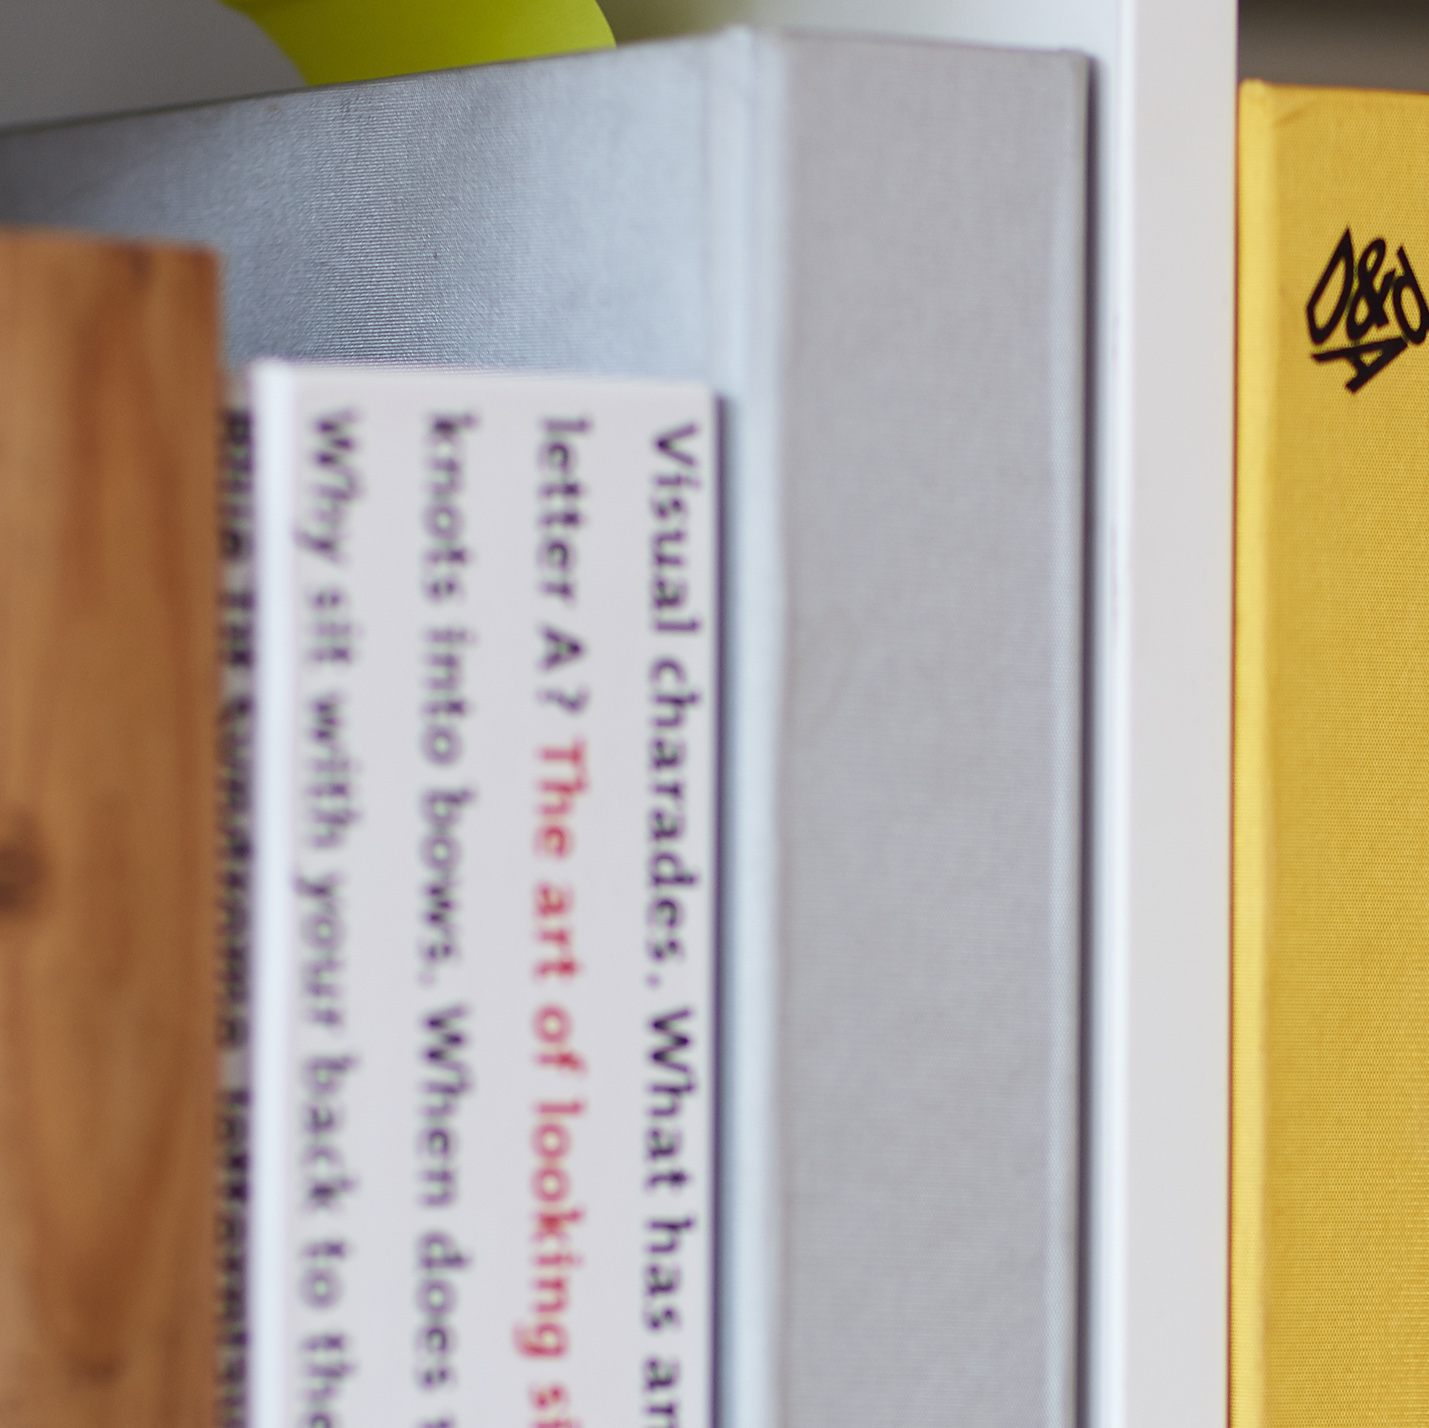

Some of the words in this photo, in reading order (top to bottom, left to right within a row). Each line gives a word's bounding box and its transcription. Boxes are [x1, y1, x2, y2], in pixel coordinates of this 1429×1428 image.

[295, 408, 361, 563] Why
[421, 411, 480, 604] knots
[538, 417, 592, 604] letter
[651, 423, 701, 633] Visual
[308, 588, 361, 665] sit
[421, 626, 477, 768] into
[308, 692, 361, 849] with
[536, 737, 589, 858] The
[649, 657, 701, 987] charades.
[294, 872, 343, 1031] your
[419, 786, 477, 987] bows.
[533, 882, 582, 978] art
[418, 1003, 474, 1209] When
[532, 1003, 587, 1076] of
[646, 1007, 698, 1189] What
[301, 1054, 358, 1214] back
[302, 1239, 348, 1310] to
[514, 1098, 586, 1360] looking
[645, 1216, 696, 1332] has
[416, 1229, 472, 1392] does
